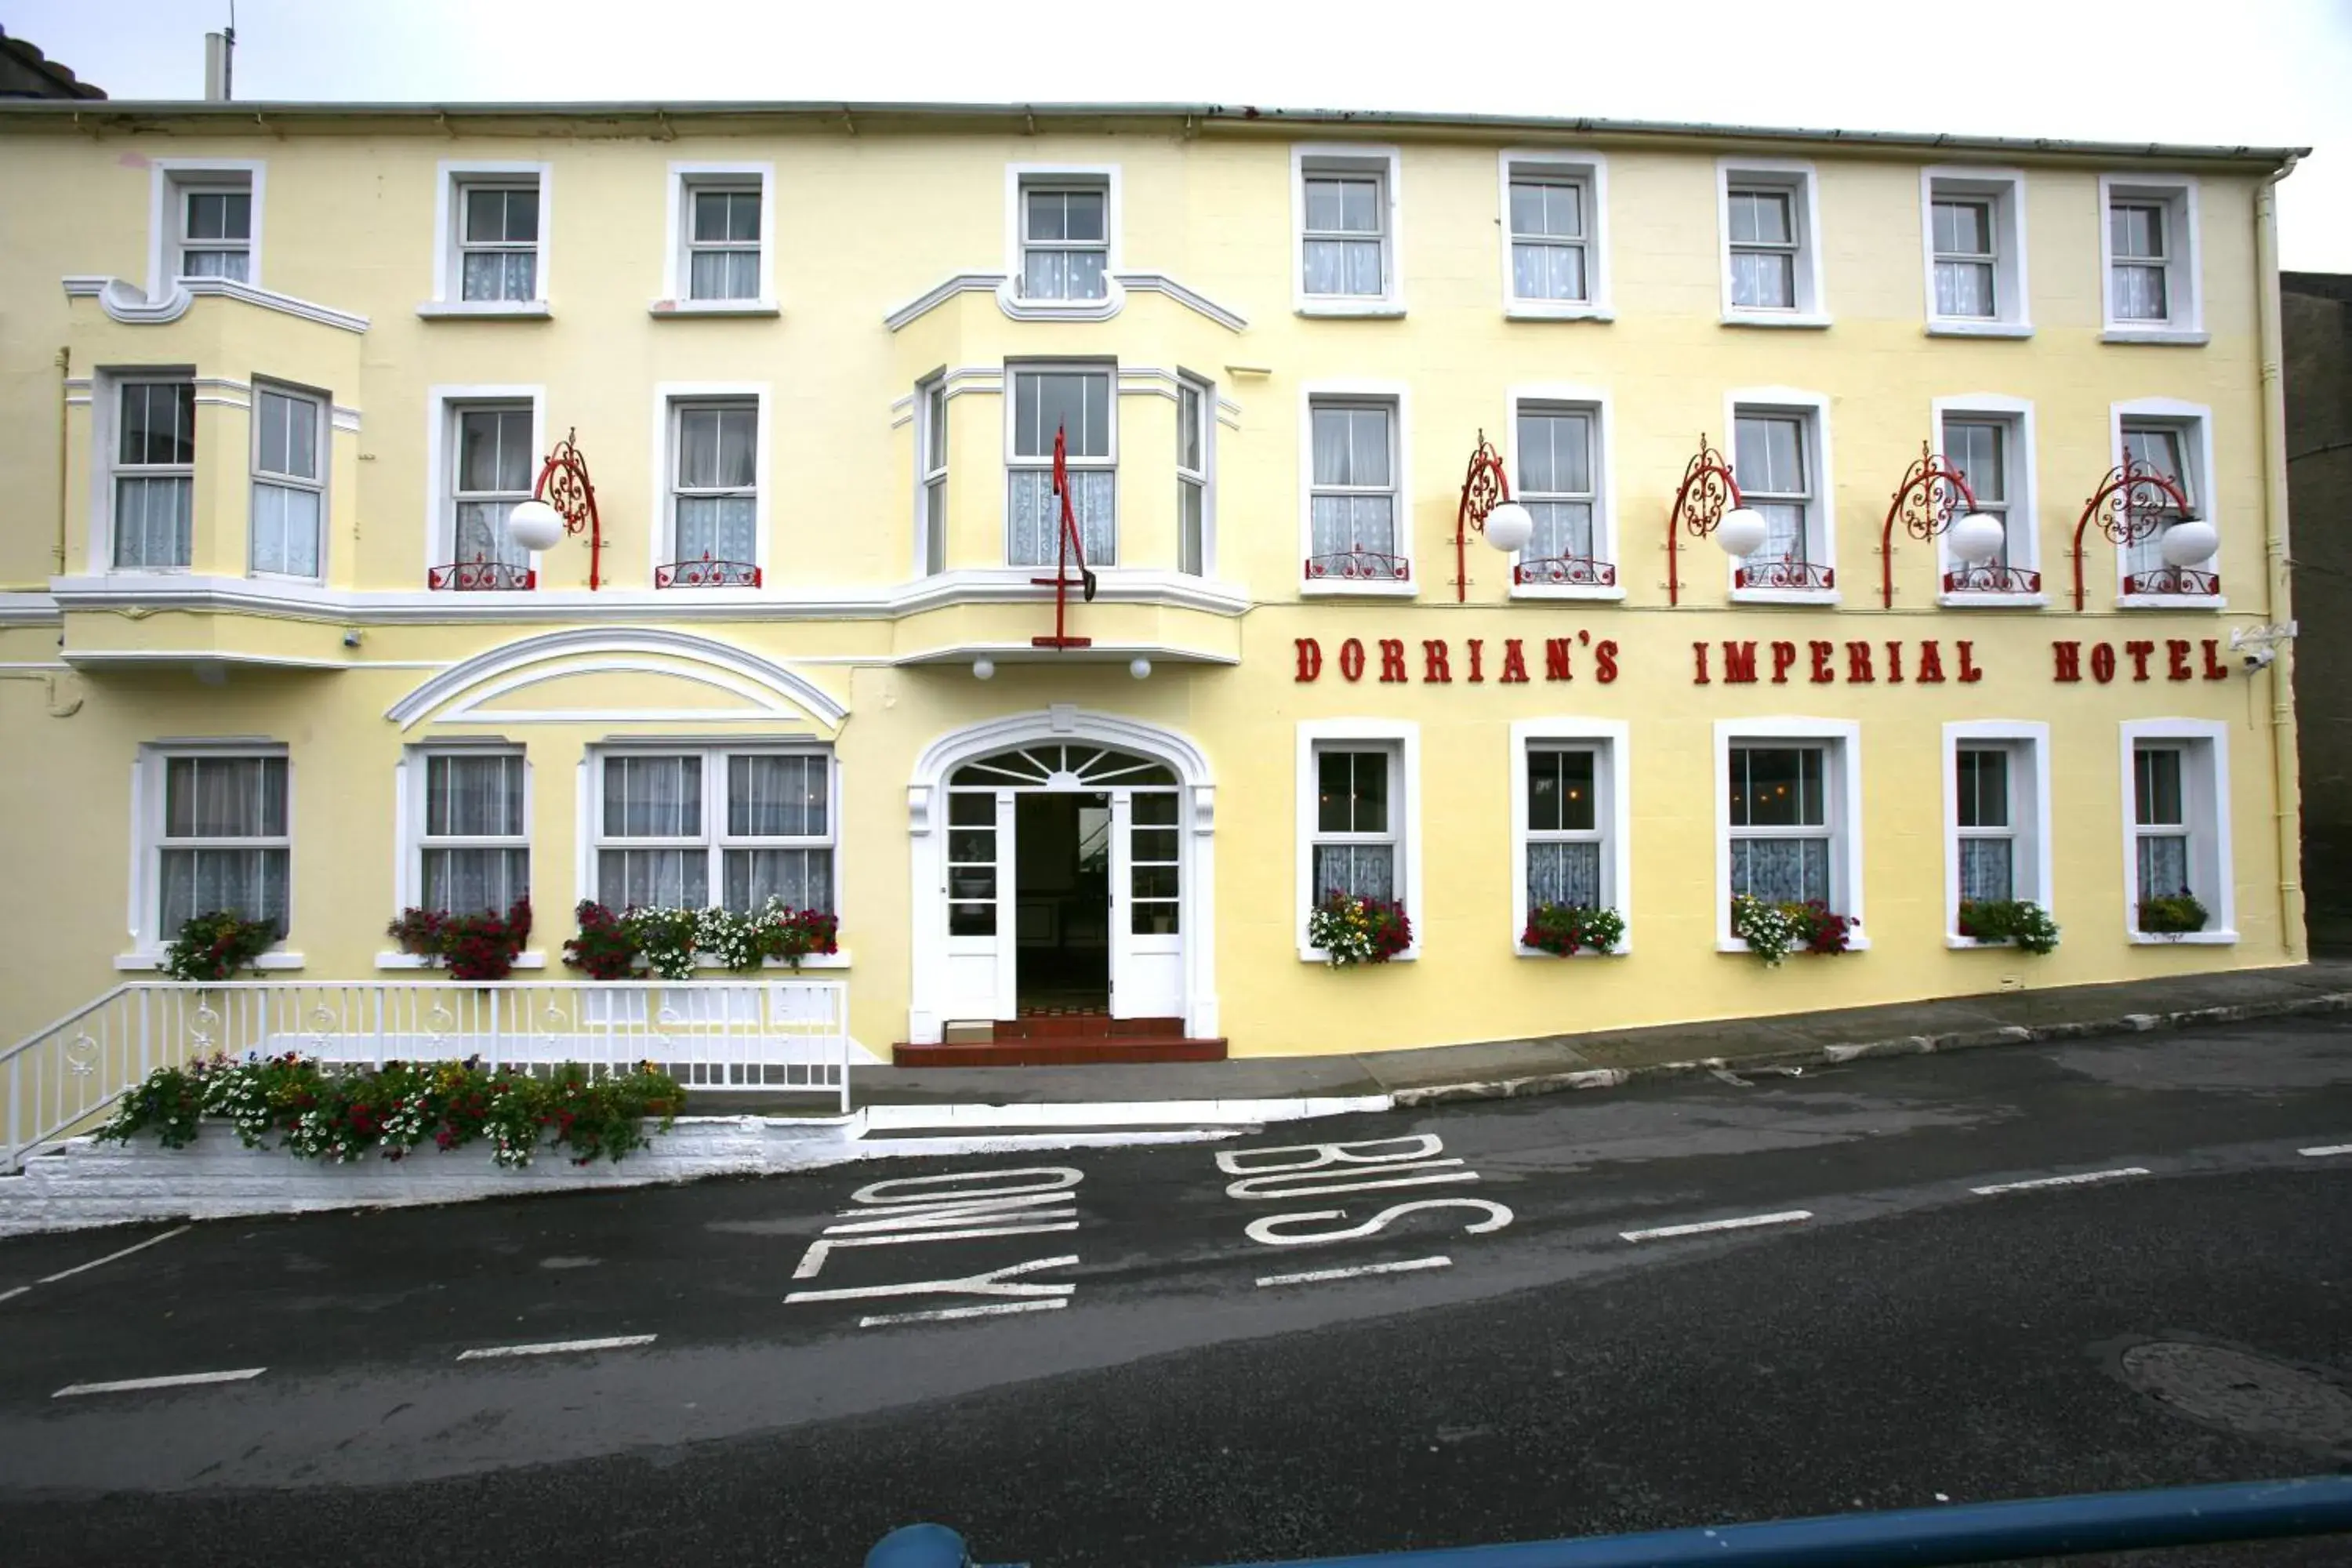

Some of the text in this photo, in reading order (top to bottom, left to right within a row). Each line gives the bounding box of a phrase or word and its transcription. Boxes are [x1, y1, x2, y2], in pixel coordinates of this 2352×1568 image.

[1294, 630, 2230, 685] DORRIAN'S IMPERIAL HOTEL
[782, 1167, 1084, 1303] ONLY
[1214, 1133, 1515, 1245] BUS
